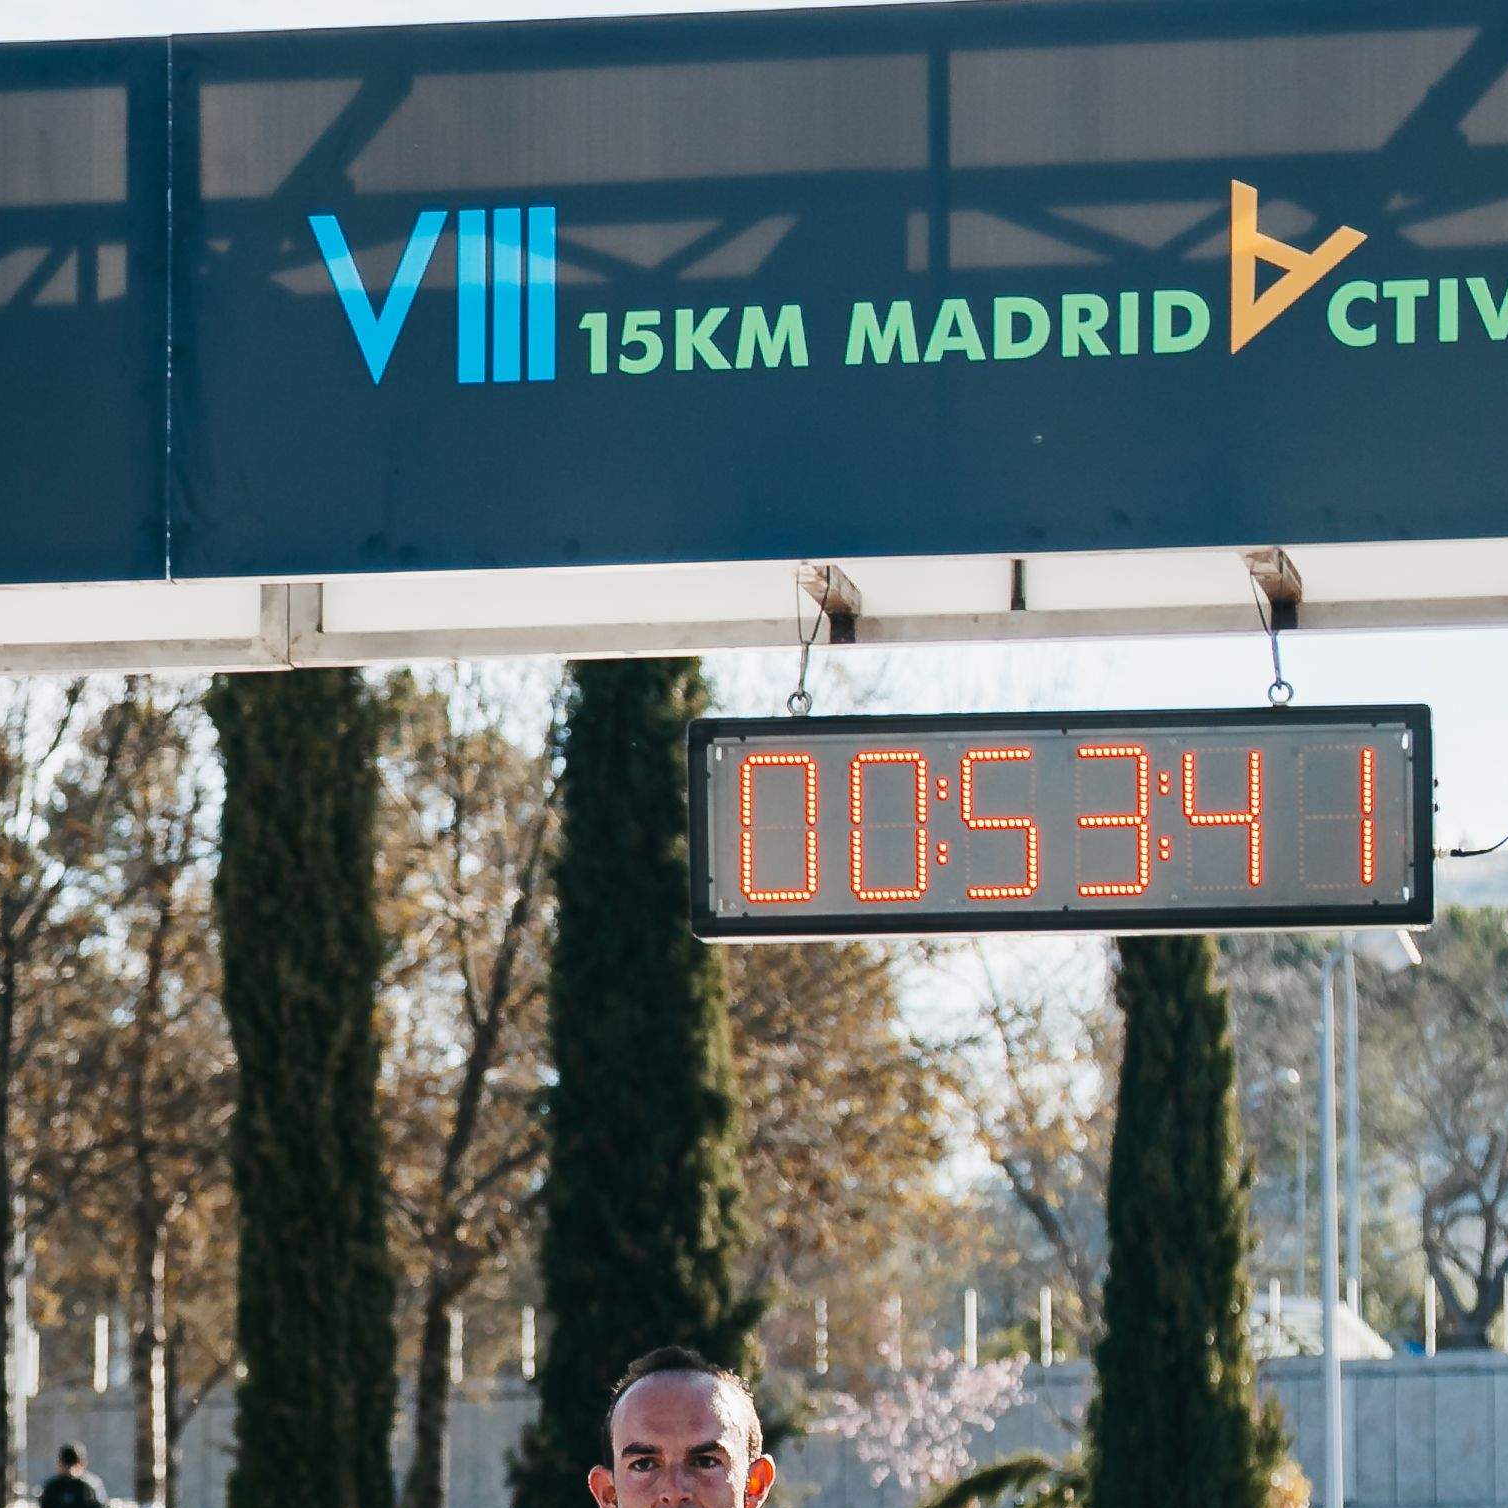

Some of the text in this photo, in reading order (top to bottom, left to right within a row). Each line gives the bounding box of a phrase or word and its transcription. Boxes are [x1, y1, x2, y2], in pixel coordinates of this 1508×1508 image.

[308, 205, 557, 384] VIII
[579, 303, 809, 376] 15KM
[844, 288, 1210, 366] MADRID
[740, 746, 1376, 903] 00:53:41
